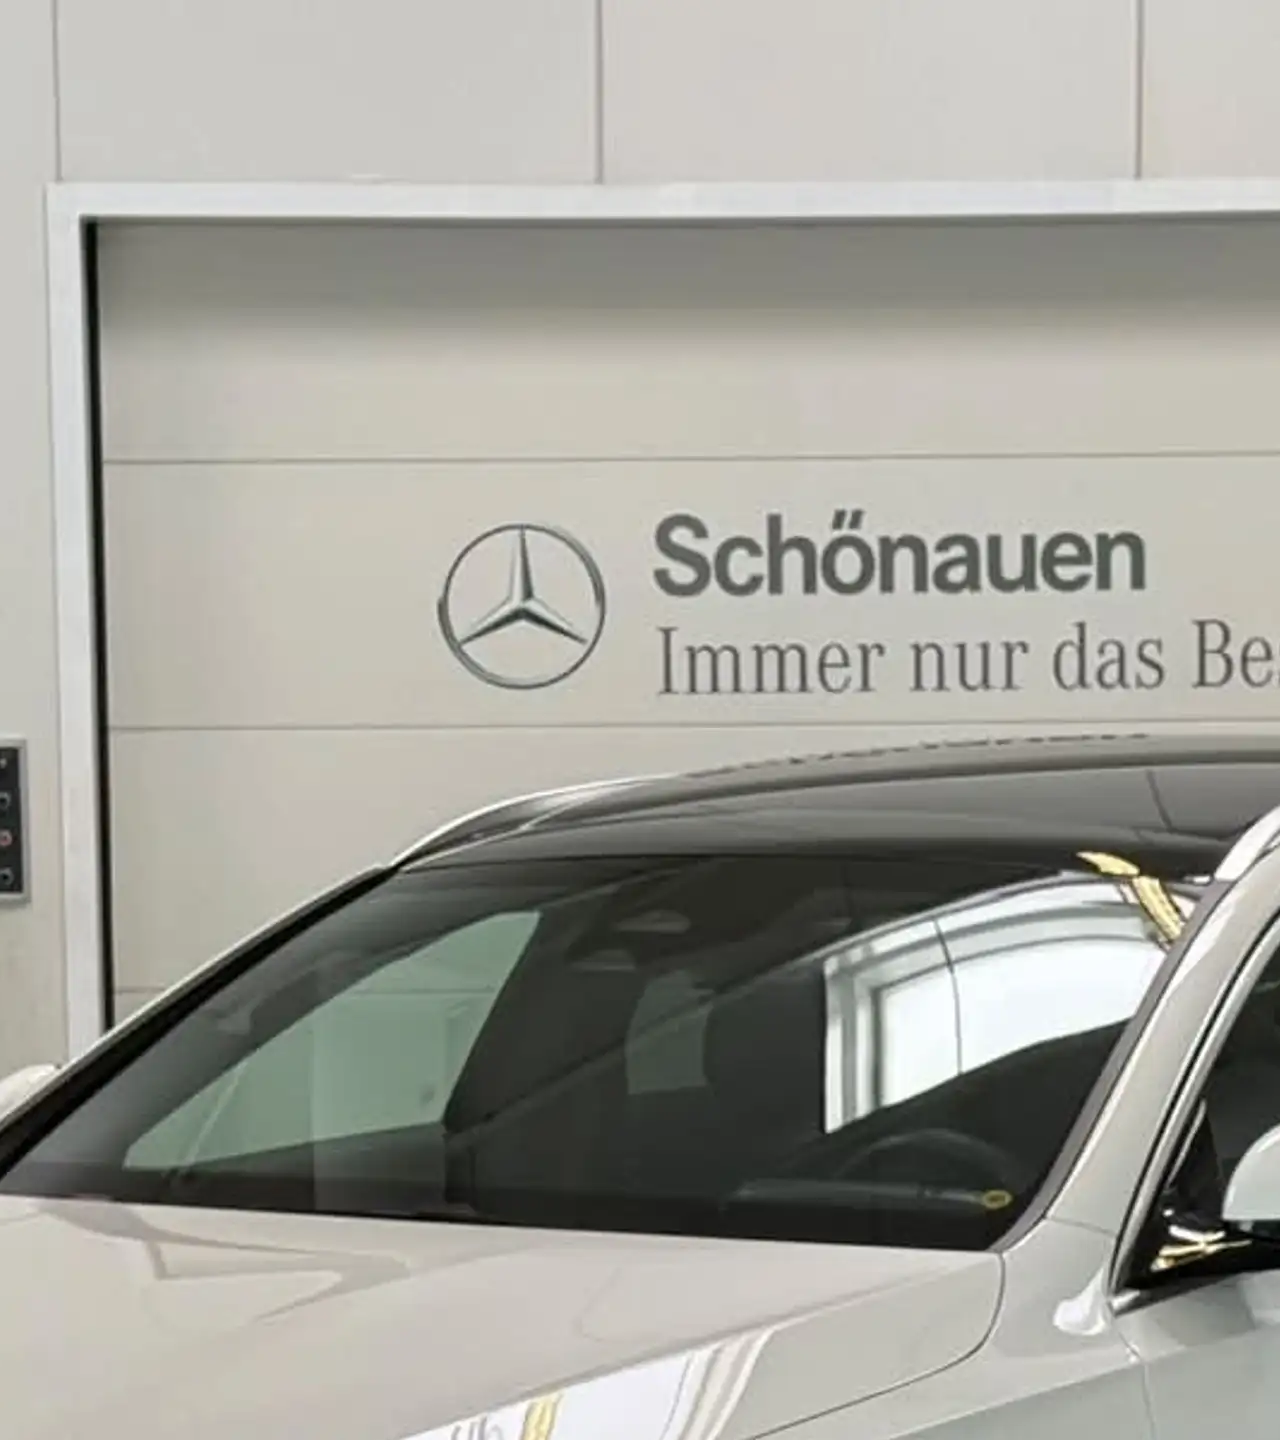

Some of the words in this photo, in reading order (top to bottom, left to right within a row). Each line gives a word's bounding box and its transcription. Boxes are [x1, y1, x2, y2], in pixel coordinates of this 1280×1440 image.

[654, 509, 1146, 597] Schönauen
[657, 627, 885, 696] Immer
[909, 637, 1029, 693] nur
[1052, 621, 1166, 690] das
